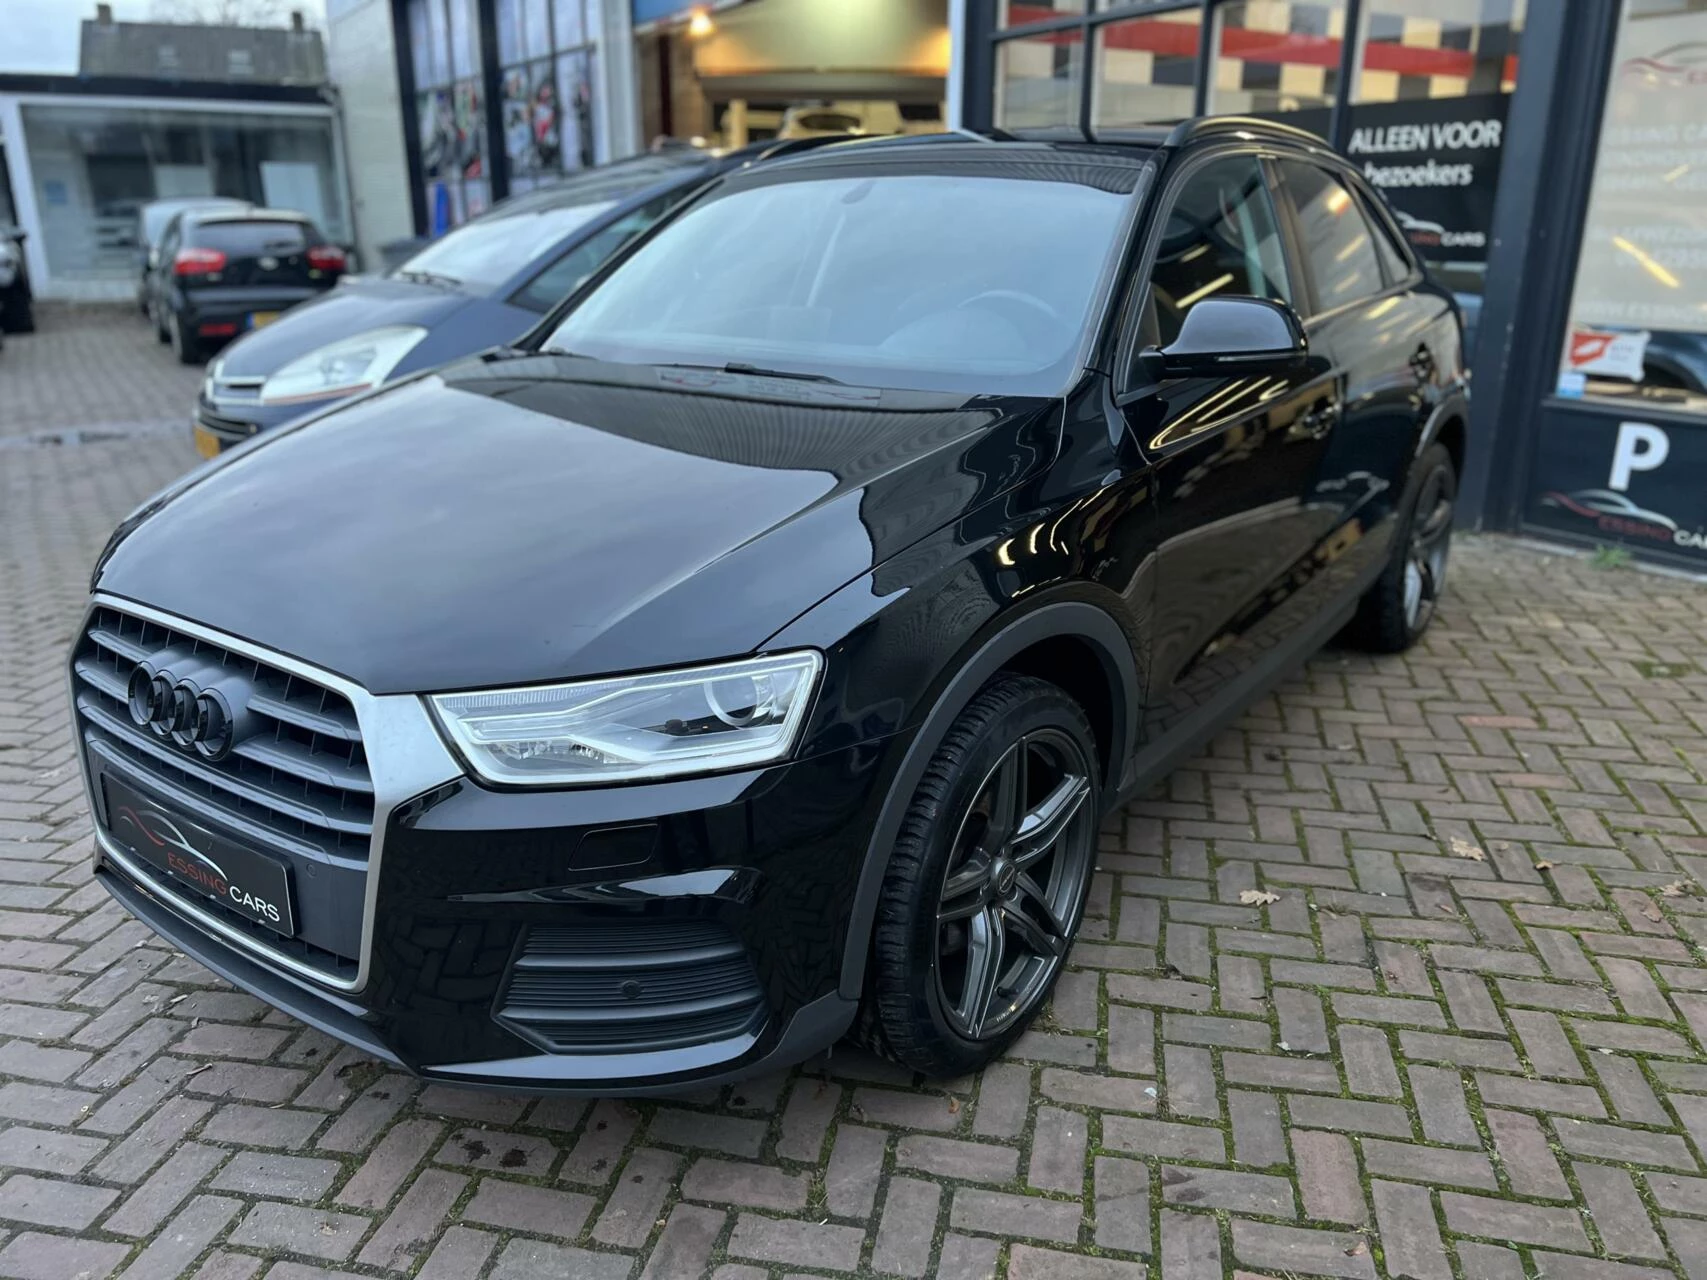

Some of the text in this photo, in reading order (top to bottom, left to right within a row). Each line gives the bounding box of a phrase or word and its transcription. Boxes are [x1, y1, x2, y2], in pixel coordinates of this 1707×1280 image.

[1347, 119, 1502, 154] ALLEEN VOOR
[1440, 231, 1486, 247] CARS
[1609, 421, 1670, 491] P
[1673, 529, 1707, 549] CA
[167, 853, 280, 923] ESSING CARS
